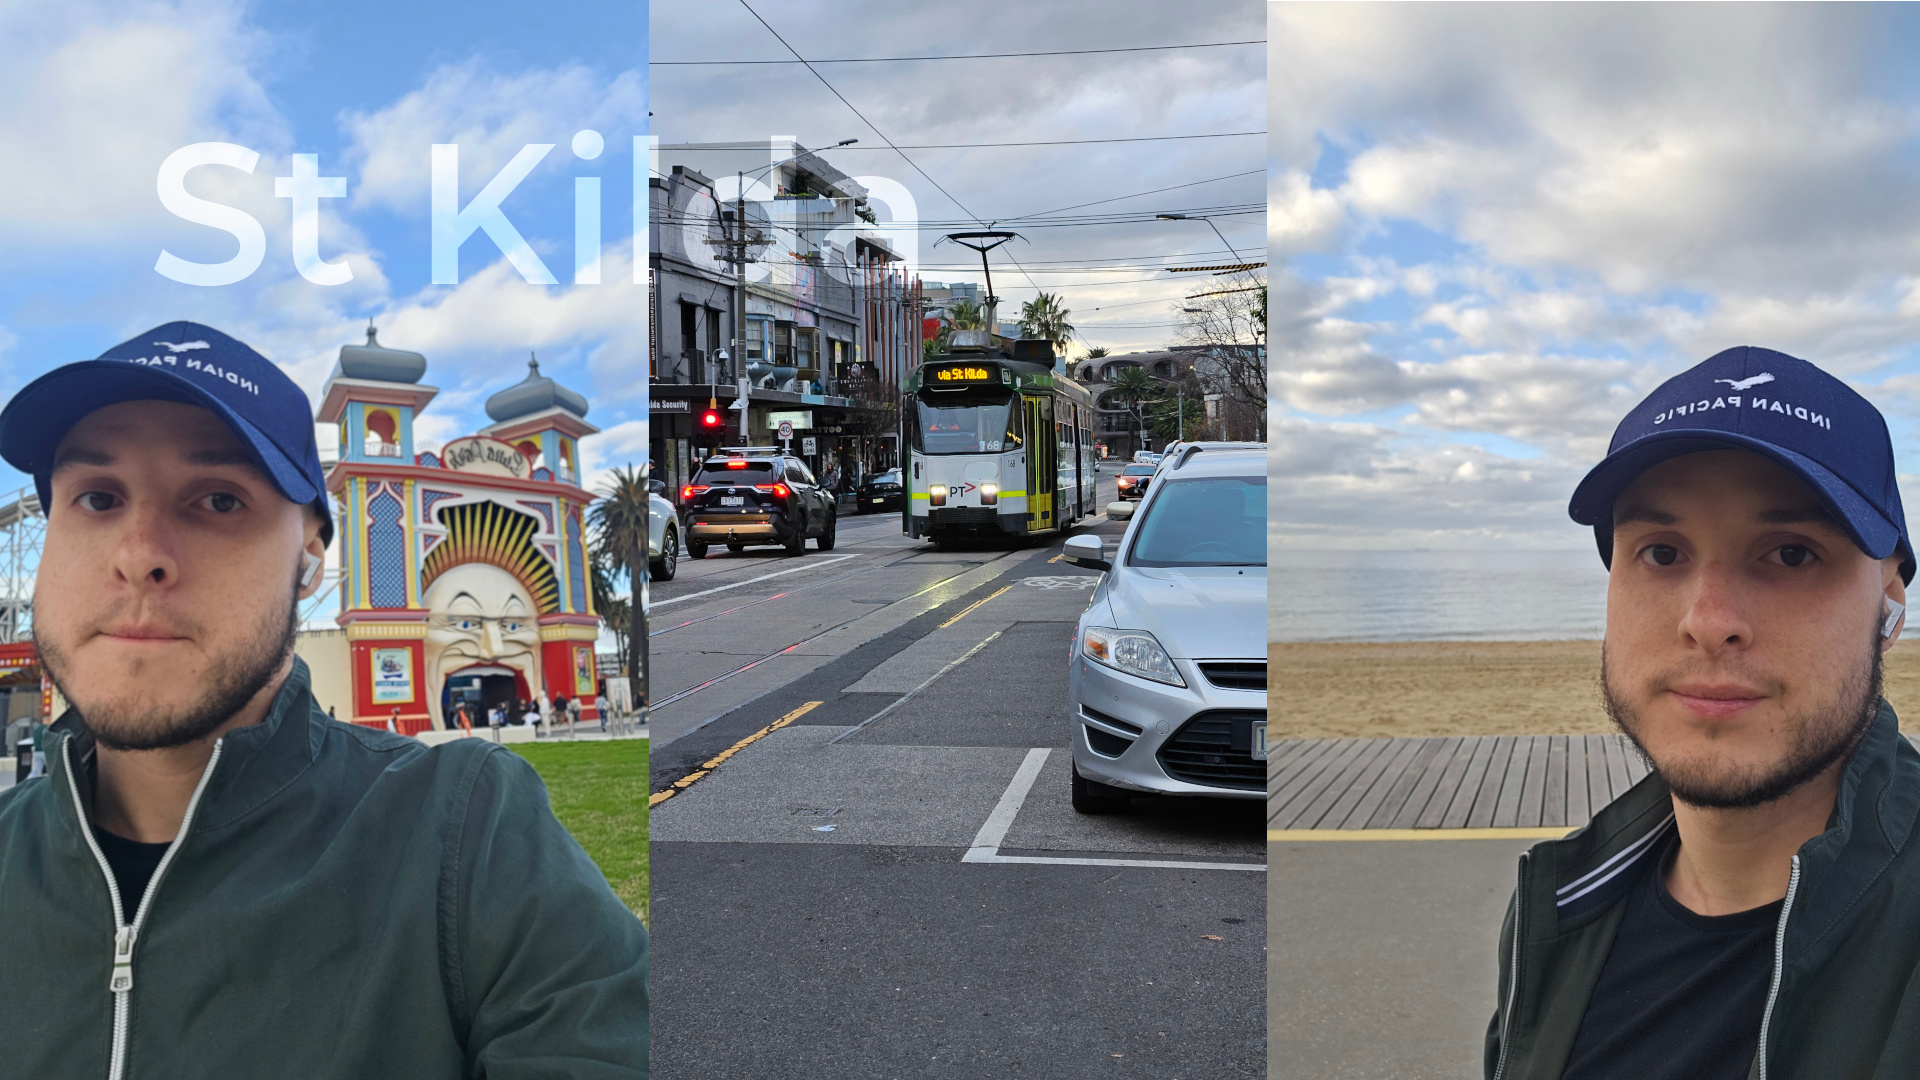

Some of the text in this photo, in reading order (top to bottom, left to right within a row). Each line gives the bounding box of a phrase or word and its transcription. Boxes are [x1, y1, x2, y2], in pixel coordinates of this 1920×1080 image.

[937, 368, 988, 380] via St Kilda
[661, 399, 688, 411] Security
[981, 440, 1000, 451] 168
